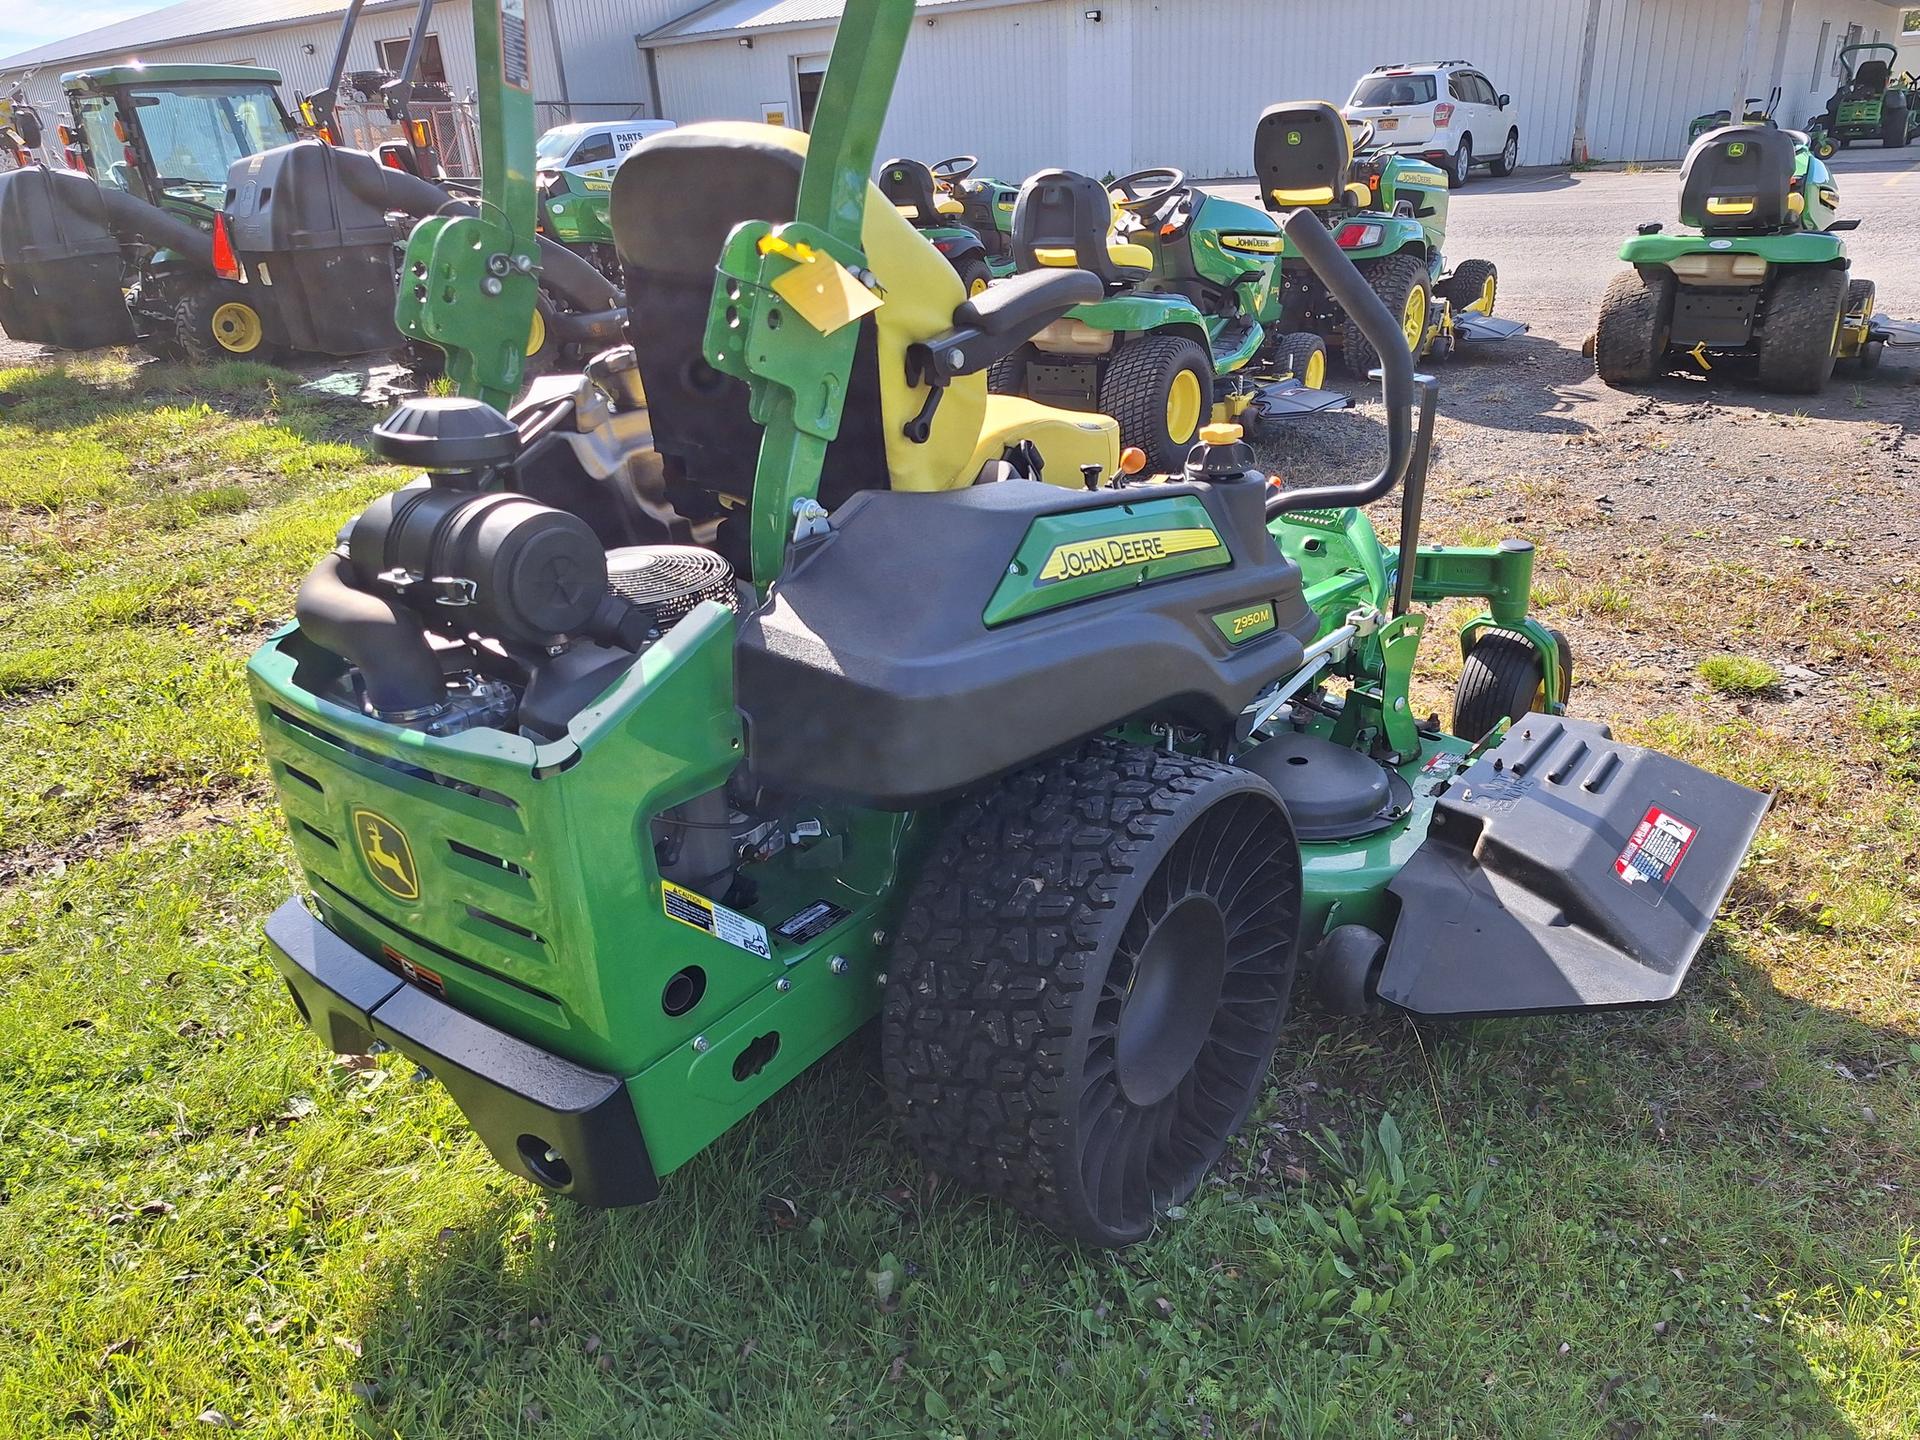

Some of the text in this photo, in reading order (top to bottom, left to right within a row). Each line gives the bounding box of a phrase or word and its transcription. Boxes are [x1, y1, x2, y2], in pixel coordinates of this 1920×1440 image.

[616, 132, 643, 142] PARTS
[1236, 238, 1270, 248] JOHN DEERE
[1059, 537, 1165, 575] JOHN DEERE
[1233, 609, 1269, 634] Z950M
[677, 888, 702, 905] CAUTION
